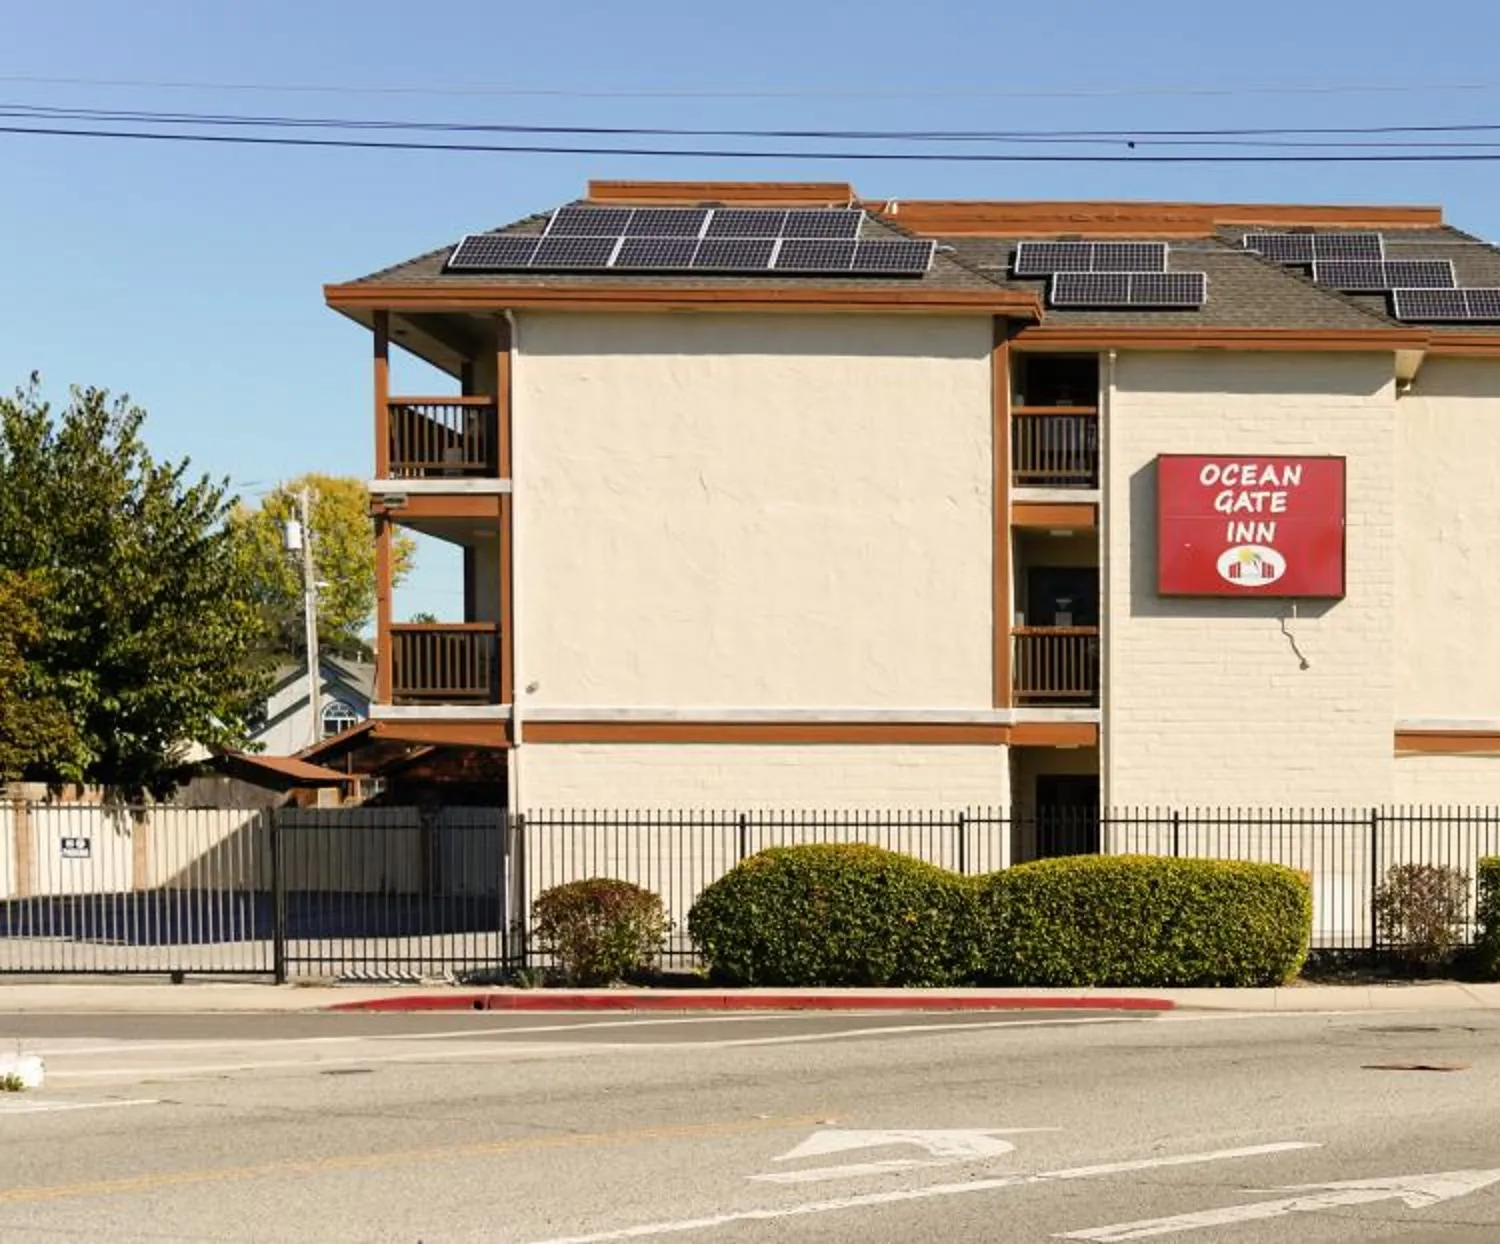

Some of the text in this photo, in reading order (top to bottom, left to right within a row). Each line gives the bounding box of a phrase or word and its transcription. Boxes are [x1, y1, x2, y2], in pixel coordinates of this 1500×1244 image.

[1200, 463, 1302, 485] OCEAN
[1214, 489, 1288, 513] GATE
[1227, 521, 1275, 542] INN
